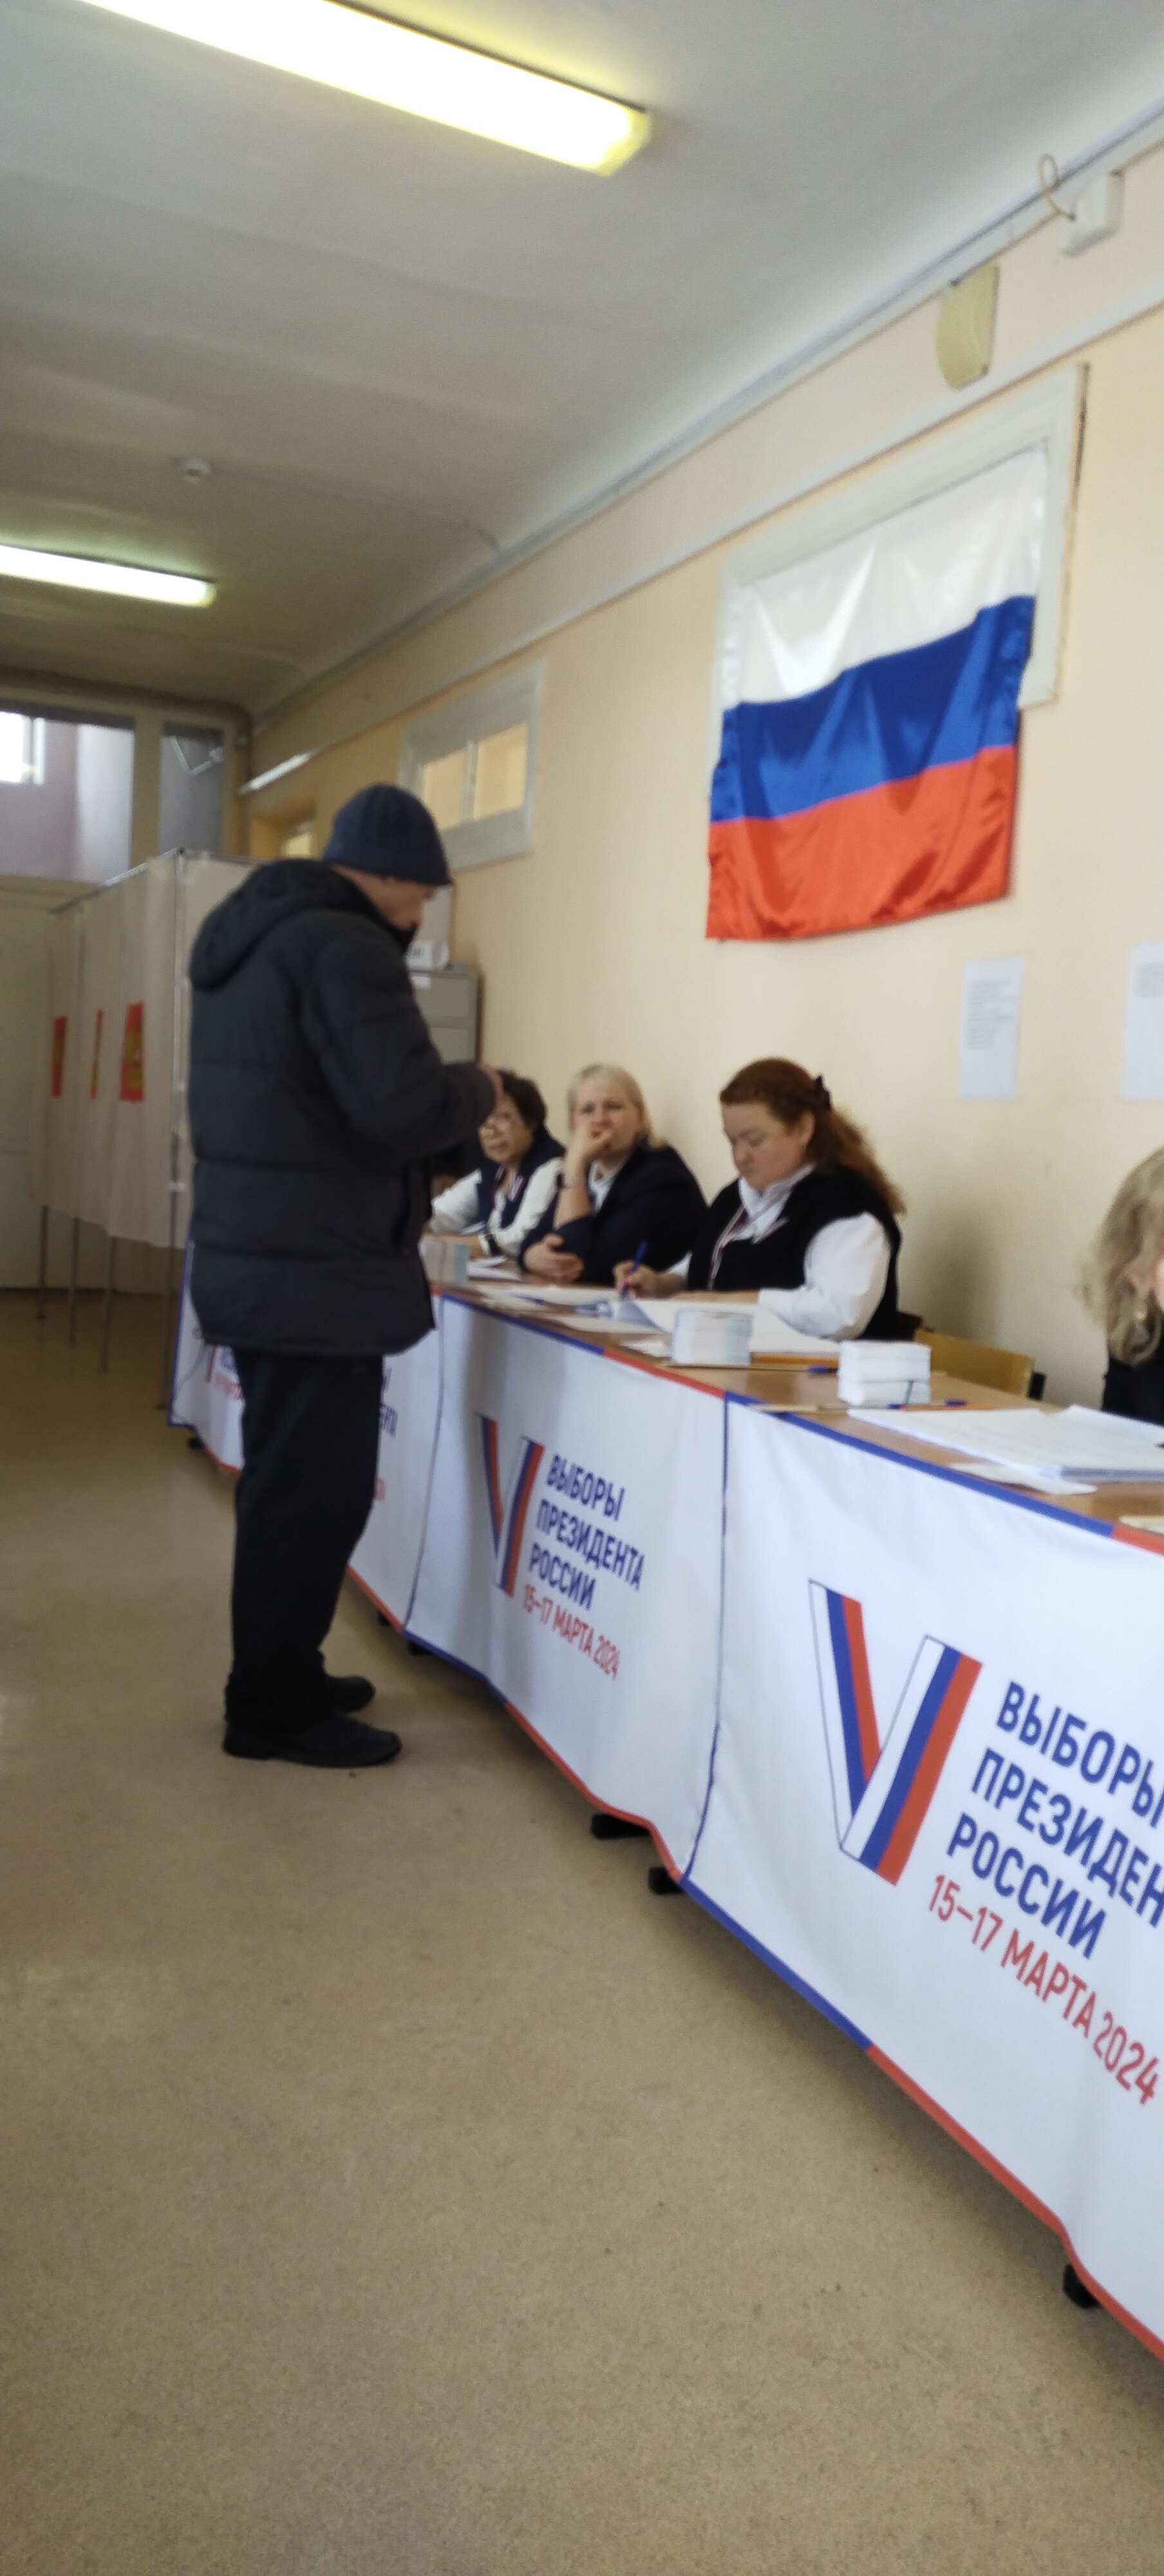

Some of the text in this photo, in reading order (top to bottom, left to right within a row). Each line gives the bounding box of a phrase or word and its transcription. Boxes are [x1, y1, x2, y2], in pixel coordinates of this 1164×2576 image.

[548, 1454, 625, 1520] ВЫБОРЫ
[529, 1544, 596, 1609] РОССИИ
[536, 1499, 644, 1590] ПРЕЗИДЕНТА
[552, 1605, 594, 1656] МАРТА
[947, 1814, 1107, 1959] РОССИИ
[1002, 1929, 1096, 2038] МАРТА
[1093, 2012, 1159, 2105] 2024
